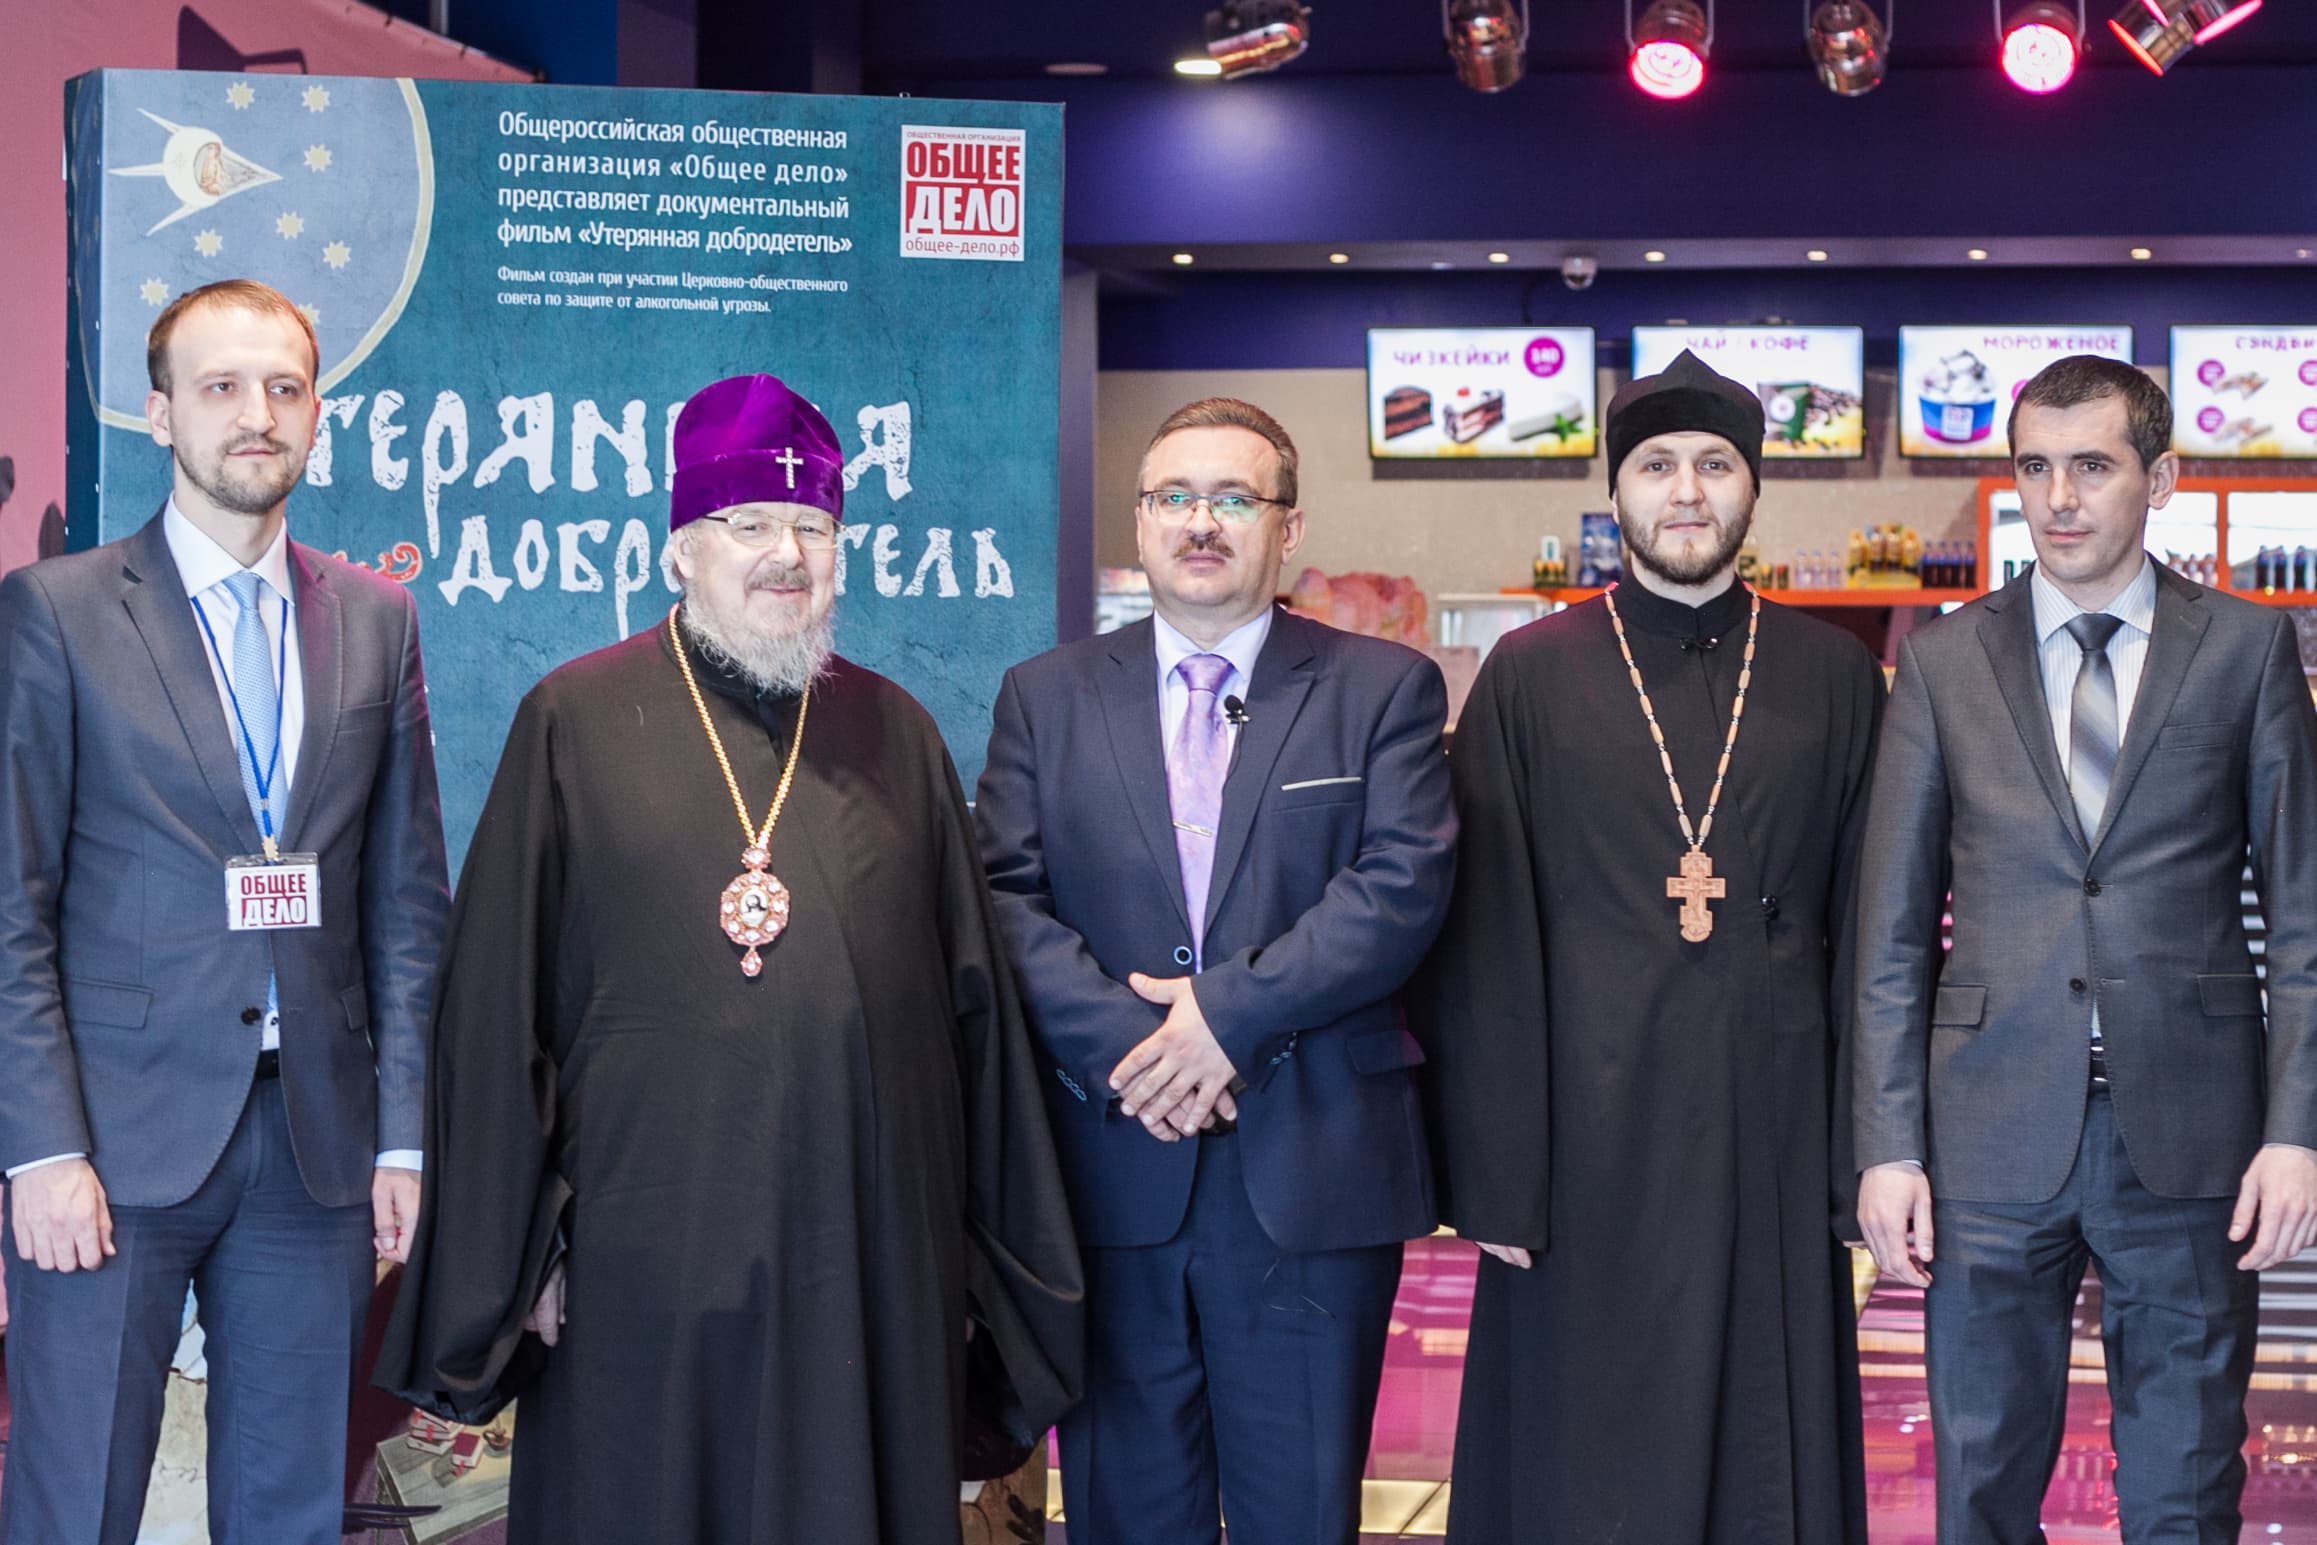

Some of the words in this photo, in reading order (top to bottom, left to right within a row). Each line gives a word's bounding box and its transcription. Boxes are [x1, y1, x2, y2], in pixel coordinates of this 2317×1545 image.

[499, 111, 684, 144] Общероссийская
[691, 120, 848, 149] общественная
[906, 131, 966, 141] ОБЩЕСТВЕННАЯ
[967, 134, 1021, 143] ОРГАНИЗАЦИЯ
[498, 152, 661, 180] организация
[670, 154, 767, 184] «Общее
[774, 163, 848, 187] дело»
[906, 141, 1021, 184] ОБЩЕЕ
[498, 188, 651, 213] представляет
[656, 194, 849, 220] документальный
[909, 185, 1017, 234] ДЕЛО
[497, 217, 572, 248] фильм
[578, 221, 700, 252] «Утерянная
[706, 226, 853, 256] добродетель»
[906, 236, 1020, 257] общее-дело.рф
[497, 265, 546, 283] Фильм
[550, 270, 594, 286] создан
[598, 272, 623, 288] при
[626, 273, 679, 289] участии
[681, 271, 849, 292] Церковно-общественного
[497, 291, 542, 306] совета
[545, 294, 562, 306] по
[565, 294, 614, 310] защите
[617, 296, 631, 309] от
[635, 296, 719, 312] алкогольной
[722, 299, 772, 315] угрозы.
[1983, 333, 2120, 351] МОРОЖЕНОЕ
[241, 873, 307, 897] ОБЩЕЕ
[242, 897, 306, 928] ДЕЛО
